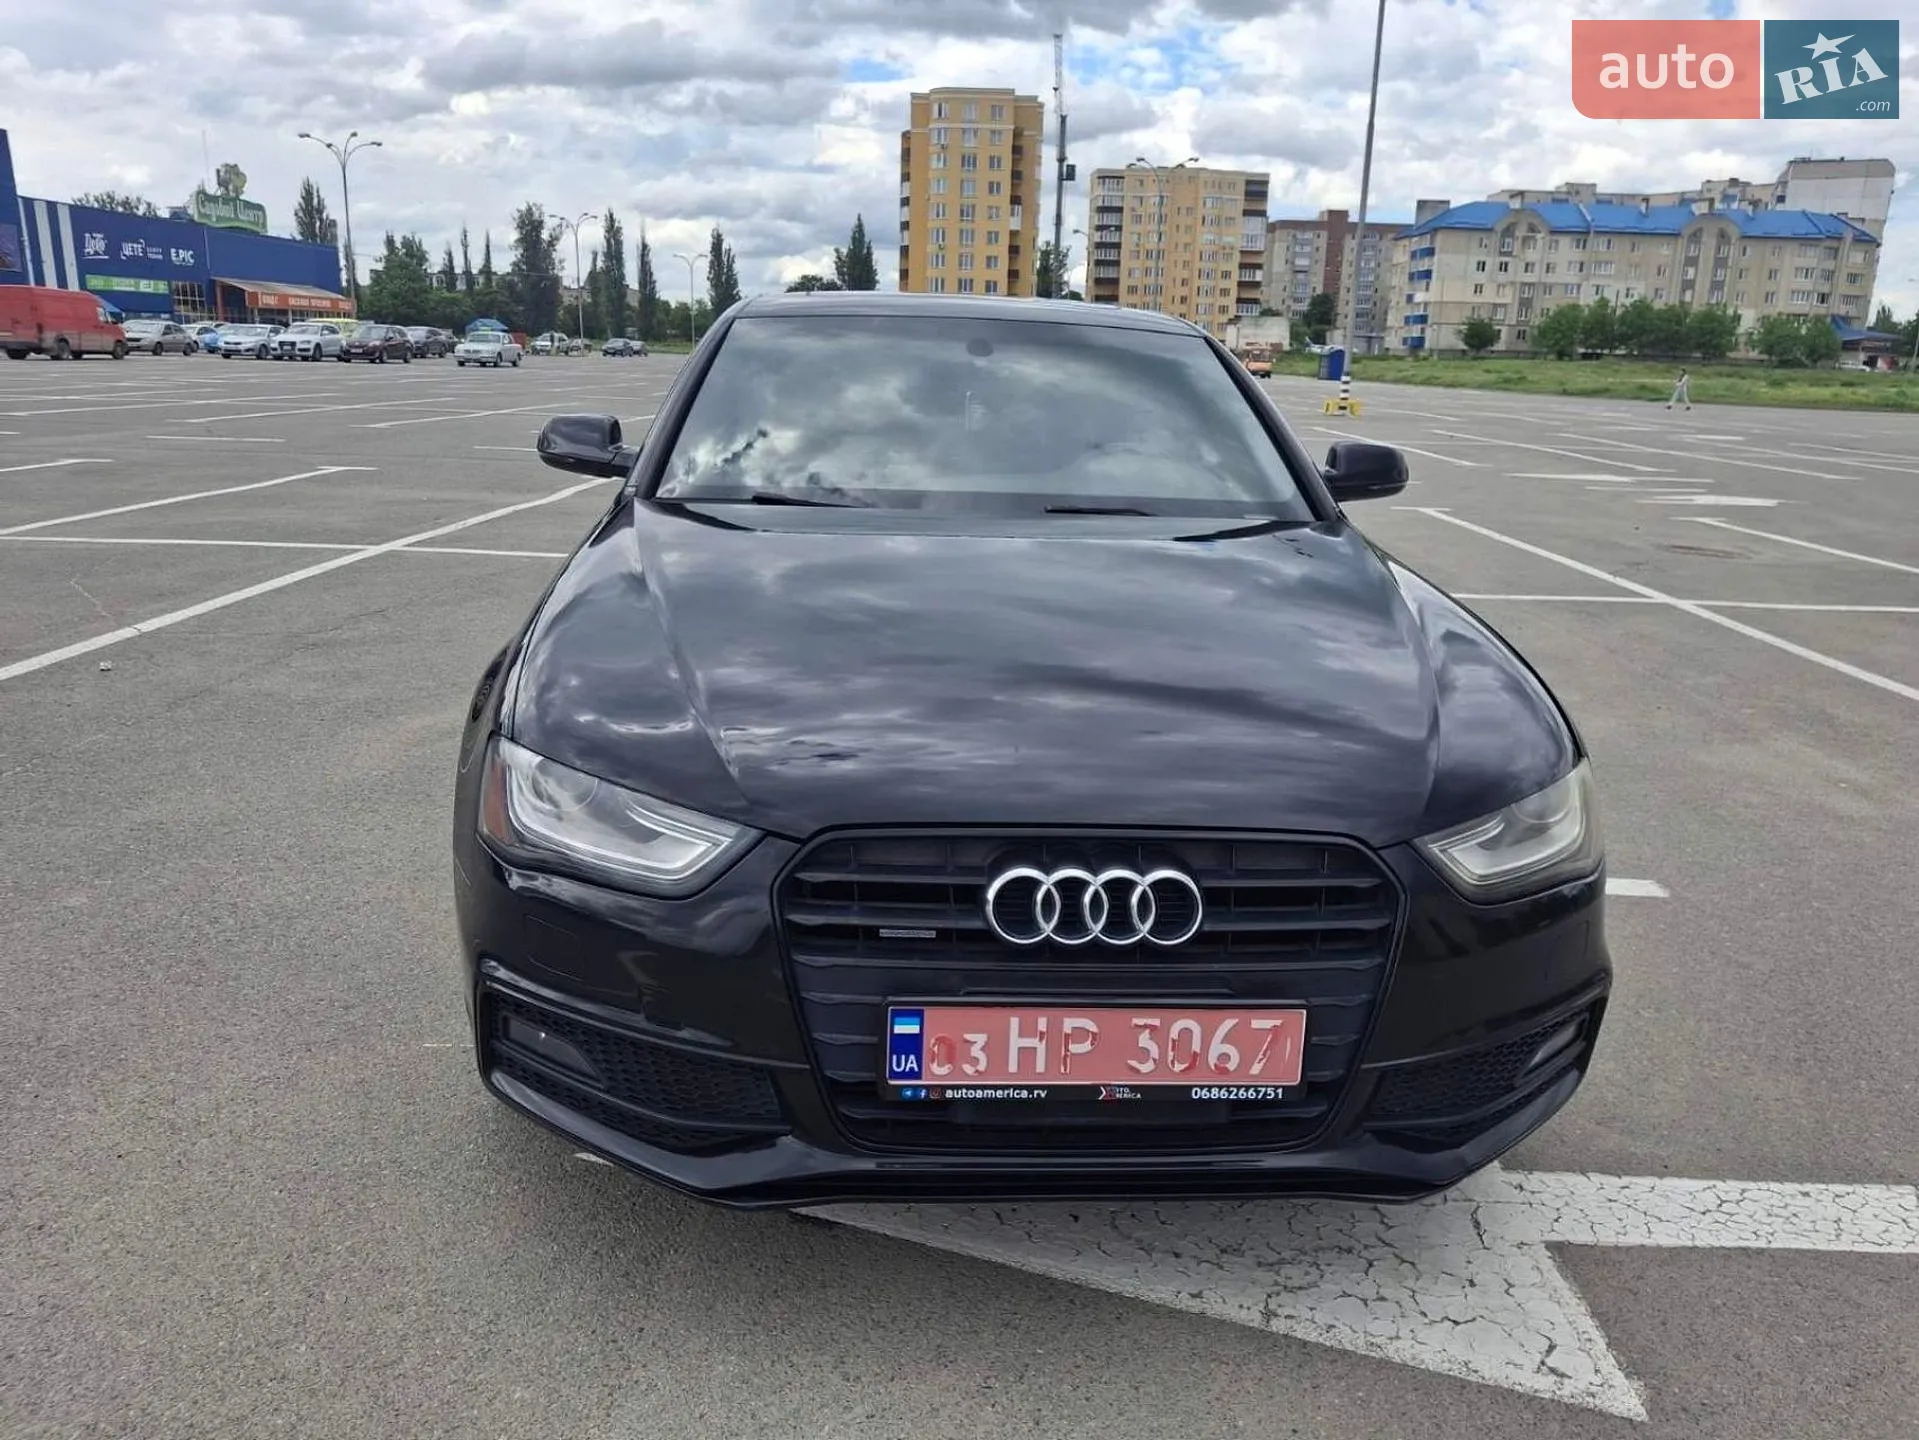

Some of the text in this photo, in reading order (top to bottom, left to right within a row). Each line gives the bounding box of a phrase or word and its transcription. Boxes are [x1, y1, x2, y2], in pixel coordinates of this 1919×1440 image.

[892, 1054, 918, 1073] UA
[1127, 1017, 1283, 1076] 3067
[945, 1087, 1048, 1099] autoamerica.rv
[1191, 1086, 1284, 1100] 0686266751
